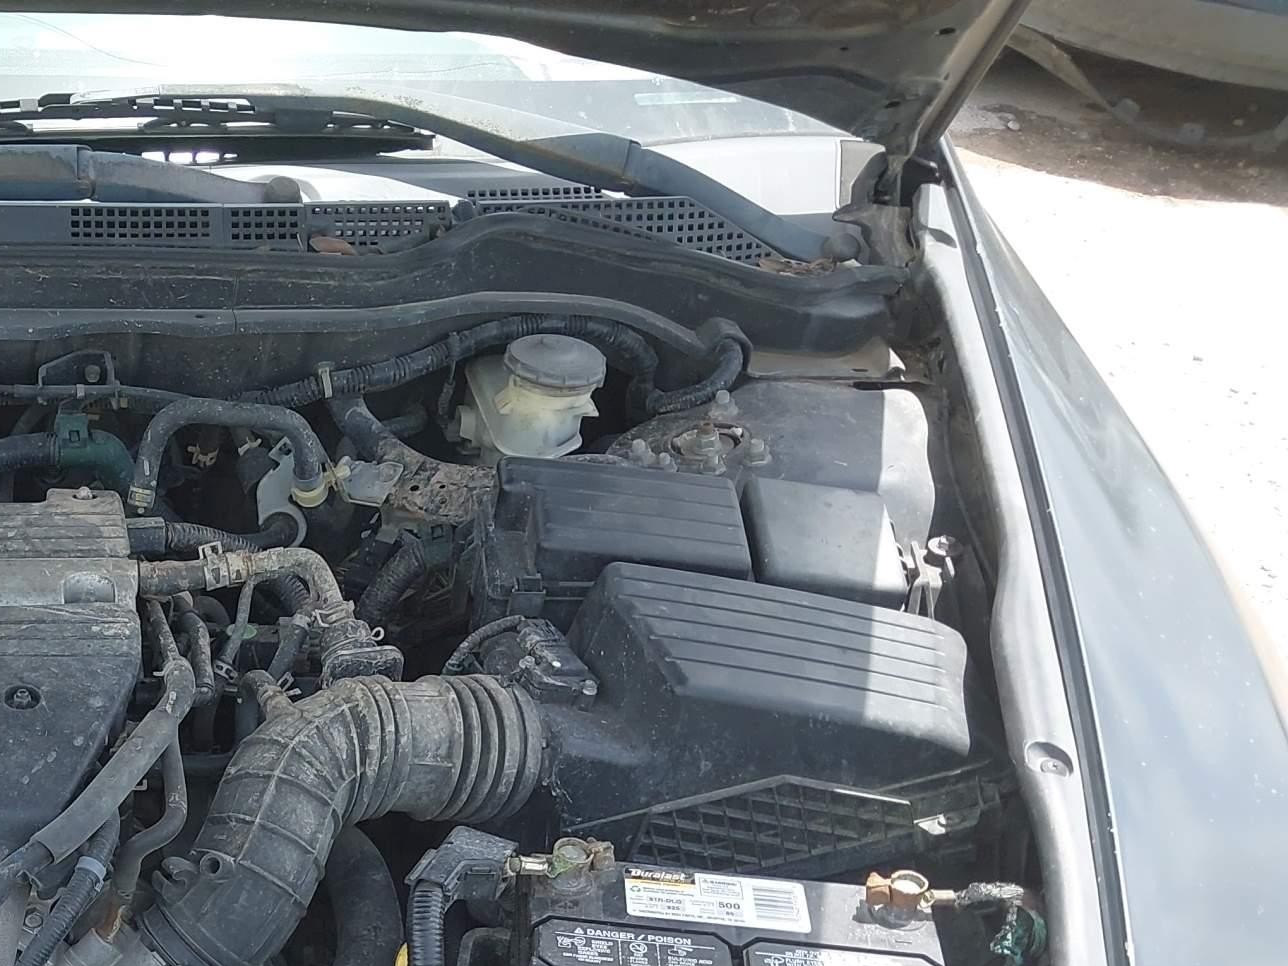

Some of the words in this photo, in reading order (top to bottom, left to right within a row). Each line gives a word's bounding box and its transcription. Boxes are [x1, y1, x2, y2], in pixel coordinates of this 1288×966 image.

[628, 868, 687, 881] Duralast
[718, 901, 741, 910] 500
[587, 928, 635, 940] DANGER
[647, 934, 692, 946] POISON
